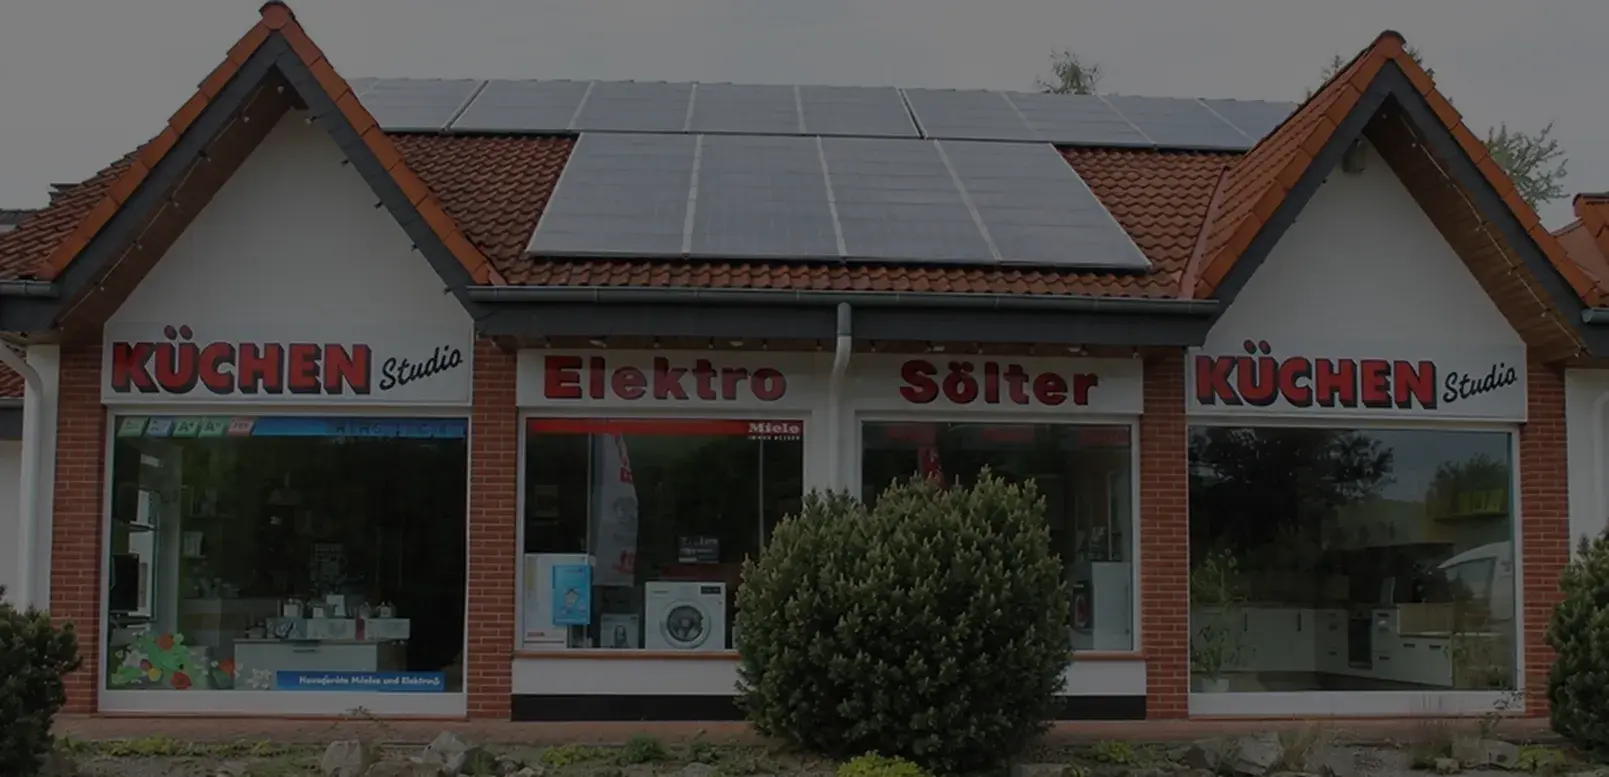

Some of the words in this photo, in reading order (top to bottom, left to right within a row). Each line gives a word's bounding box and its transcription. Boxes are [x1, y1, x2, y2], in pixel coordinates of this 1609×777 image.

[111, 325, 372, 395] KÜCHEN
[380, 344, 463, 391] Studio
[544, 355, 788, 402] Elektro
[899, 359, 1099, 406] Sölter
[1195, 339, 1438, 410] KÜCHEN
[1443, 362, 1519, 404] Studio
[748, 422, 800, 433] Miele
